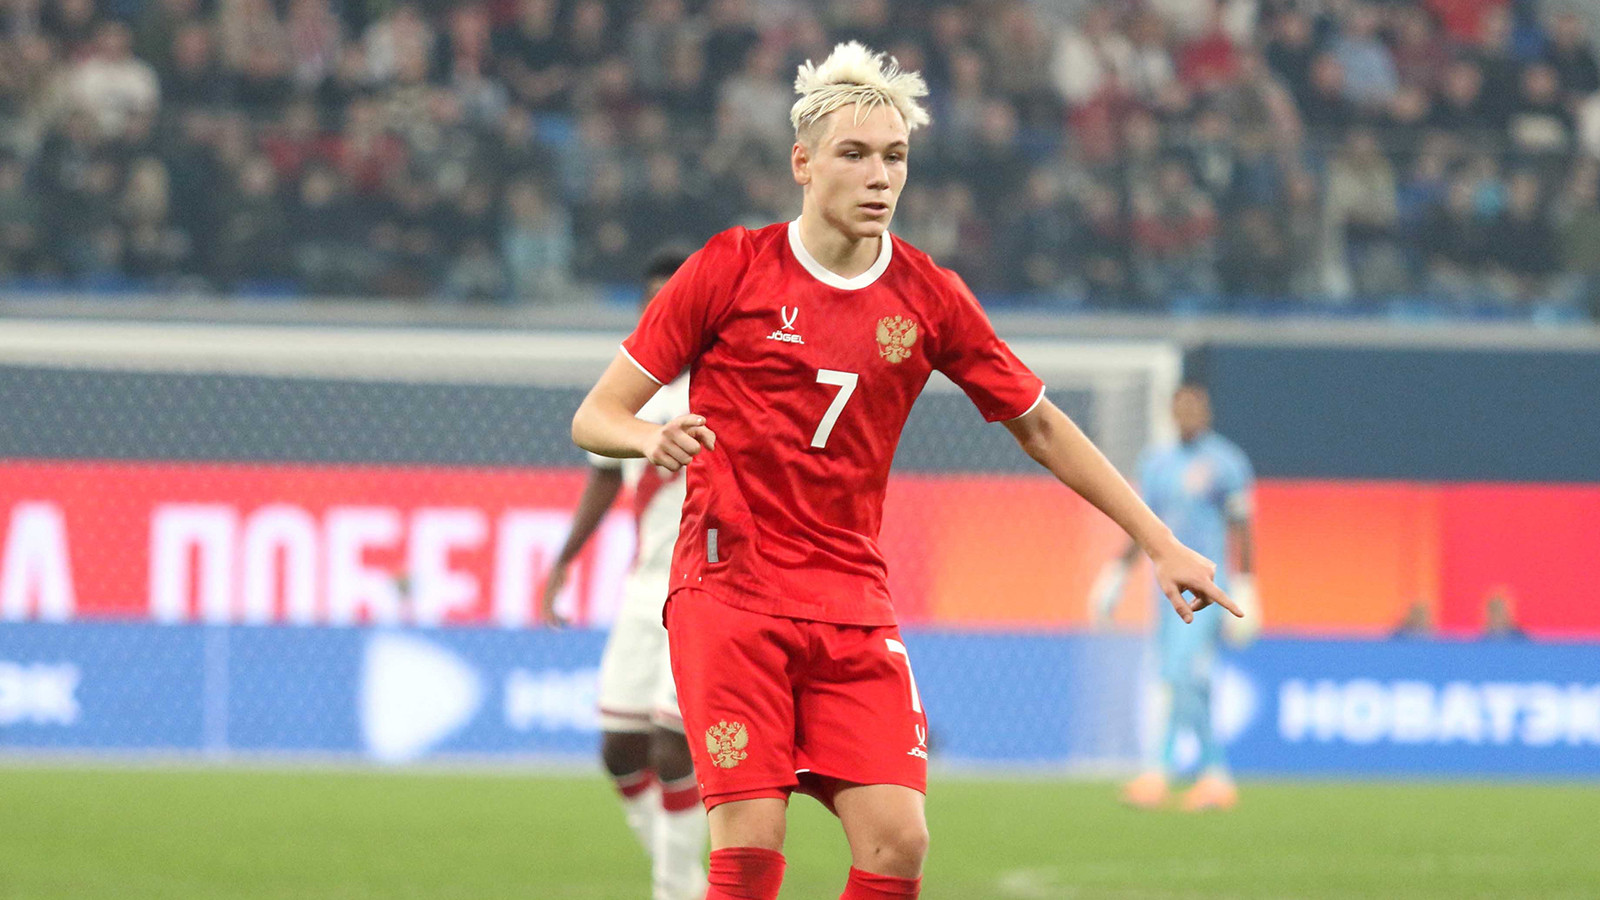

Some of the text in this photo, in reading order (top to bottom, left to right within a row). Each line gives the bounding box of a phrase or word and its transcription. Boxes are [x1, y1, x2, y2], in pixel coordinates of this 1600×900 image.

[766, 330, 805, 345] JÖGEL
[810, 368, 860, 449] 7
[884, 638, 923, 714] 7
